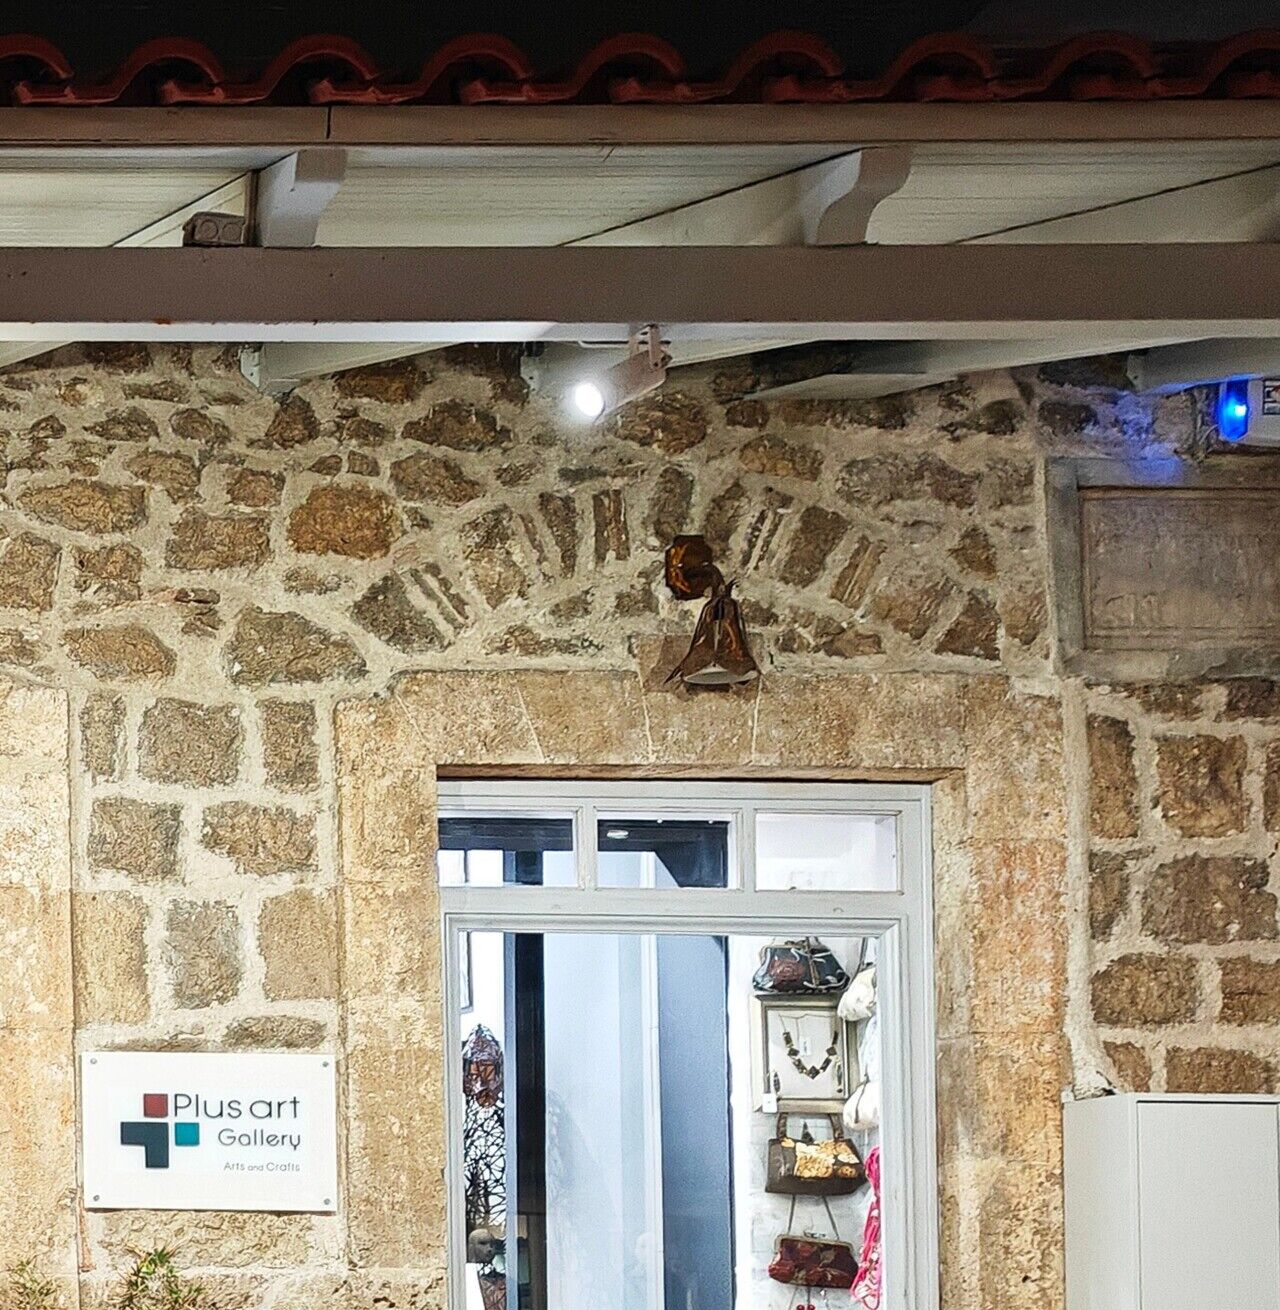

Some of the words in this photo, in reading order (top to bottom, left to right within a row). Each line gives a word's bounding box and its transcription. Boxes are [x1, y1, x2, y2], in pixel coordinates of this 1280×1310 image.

[174, 1093, 242, 1119] Plus
[249, 1096, 300, 1119] art
[218, 1128, 301, 1151] Gallery
[223, 1162, 246, 1172] Arts
[247, 1164, 264, 1172] and
[266, 1162, 300, 1172] Crafts
